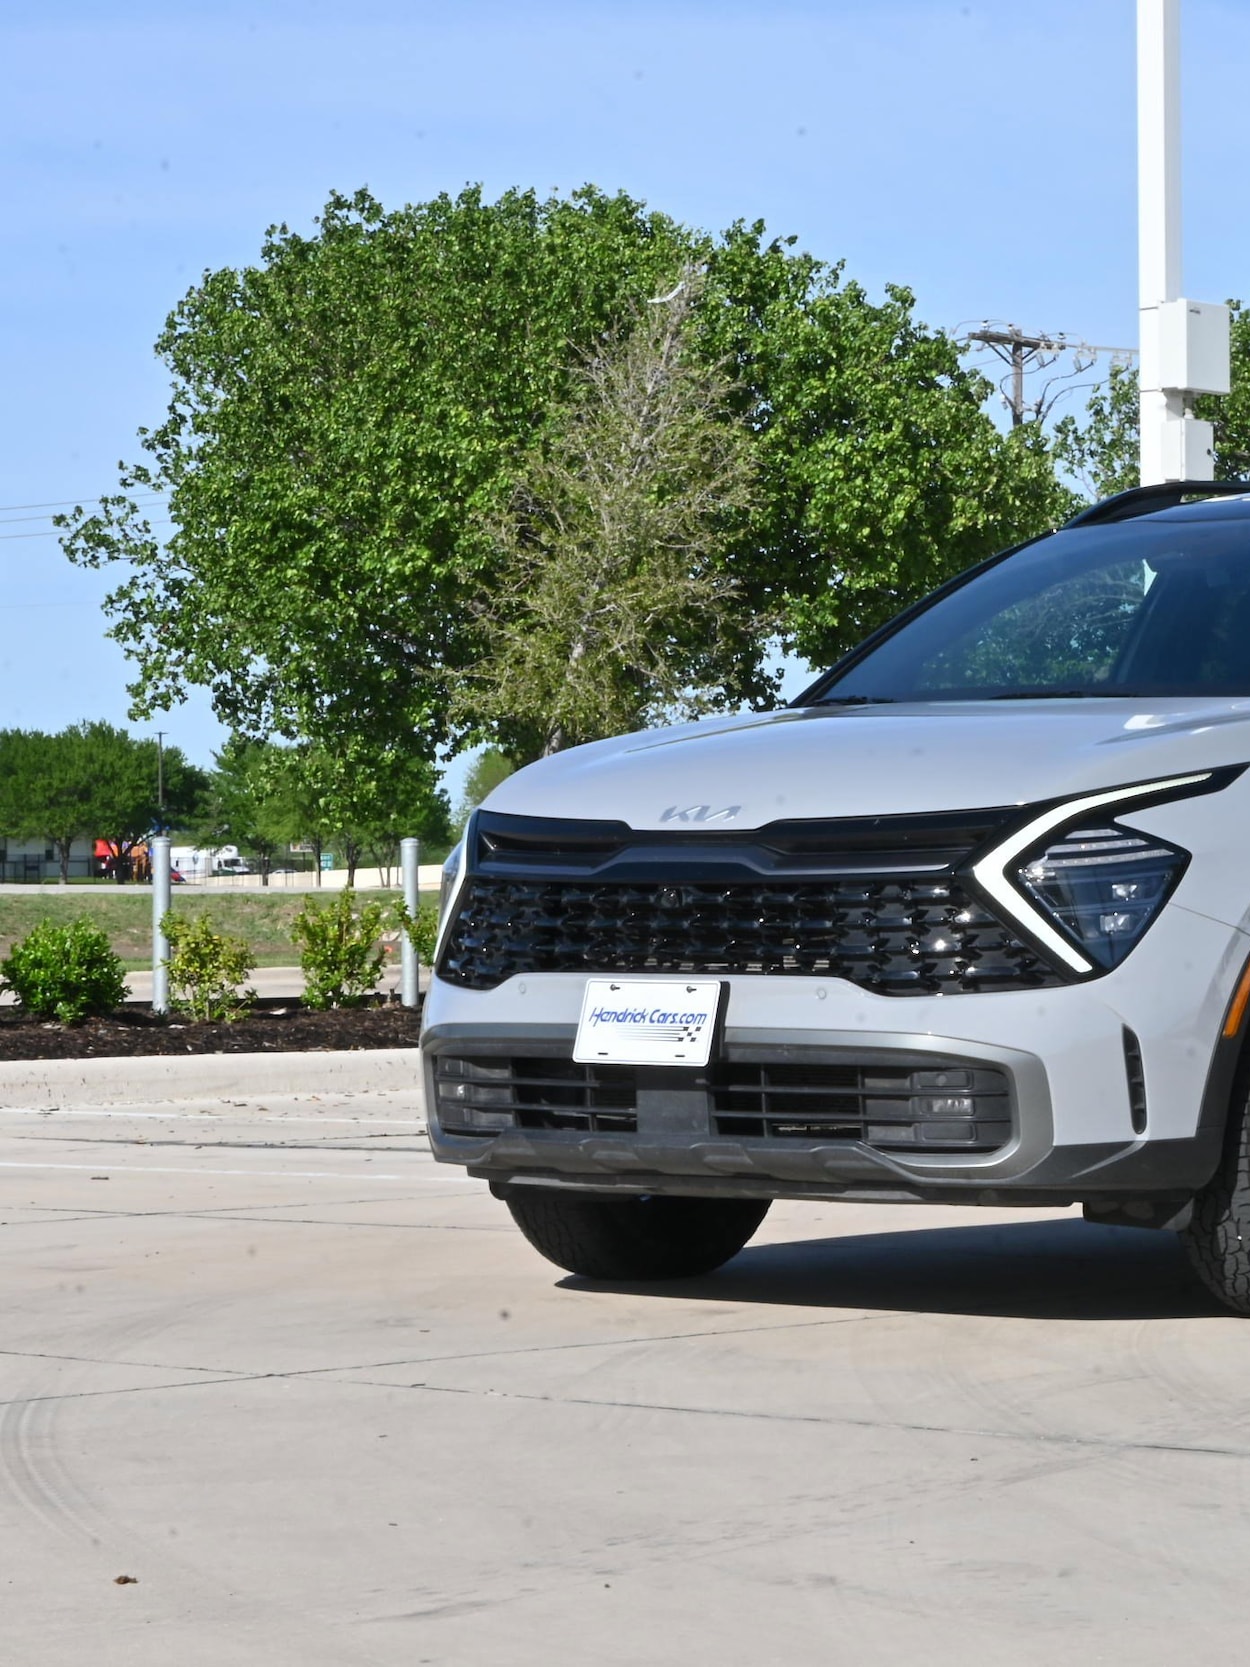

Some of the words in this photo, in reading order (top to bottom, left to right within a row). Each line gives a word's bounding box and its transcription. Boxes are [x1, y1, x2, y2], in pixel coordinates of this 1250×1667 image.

[659, 805, 742, 822] KIA
[588, 1007, 649, 1027] Hendrick
[649, 1009, 707, 1025] Cars.com
